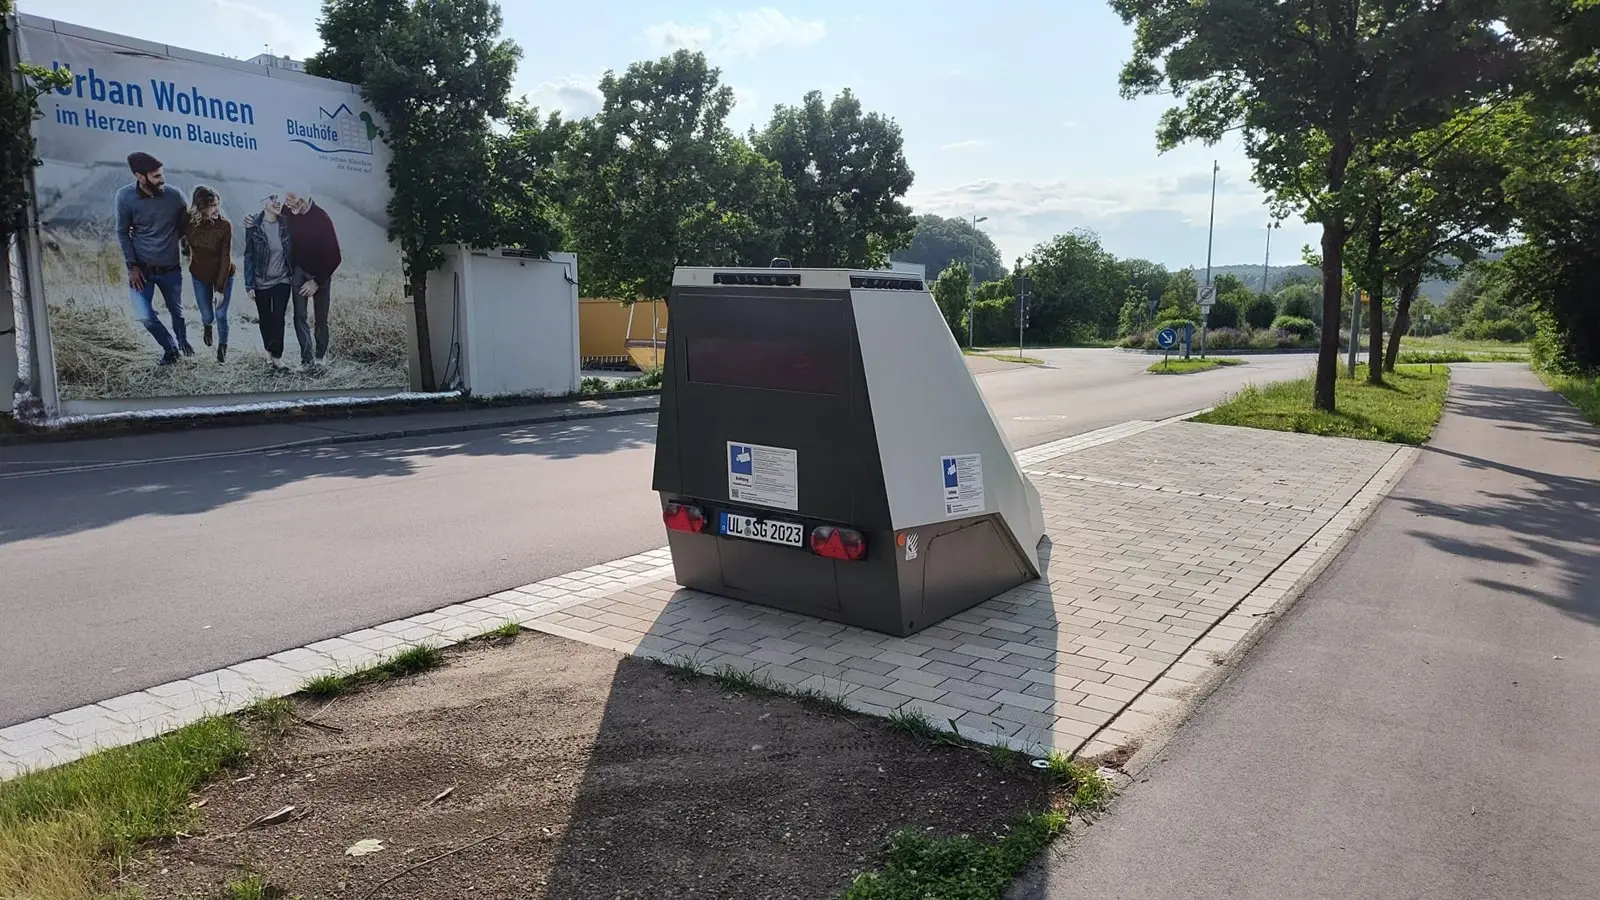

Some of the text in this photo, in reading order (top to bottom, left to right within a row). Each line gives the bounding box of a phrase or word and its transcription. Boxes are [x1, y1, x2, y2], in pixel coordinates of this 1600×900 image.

[150, 79, 254, 125] Wohnen
[56, 103, 258, 151] im Herzen von Blaustein
[287, 119, 338, 142] Blauhöfe
[728, 516, 802, 543] UL SG 2023
